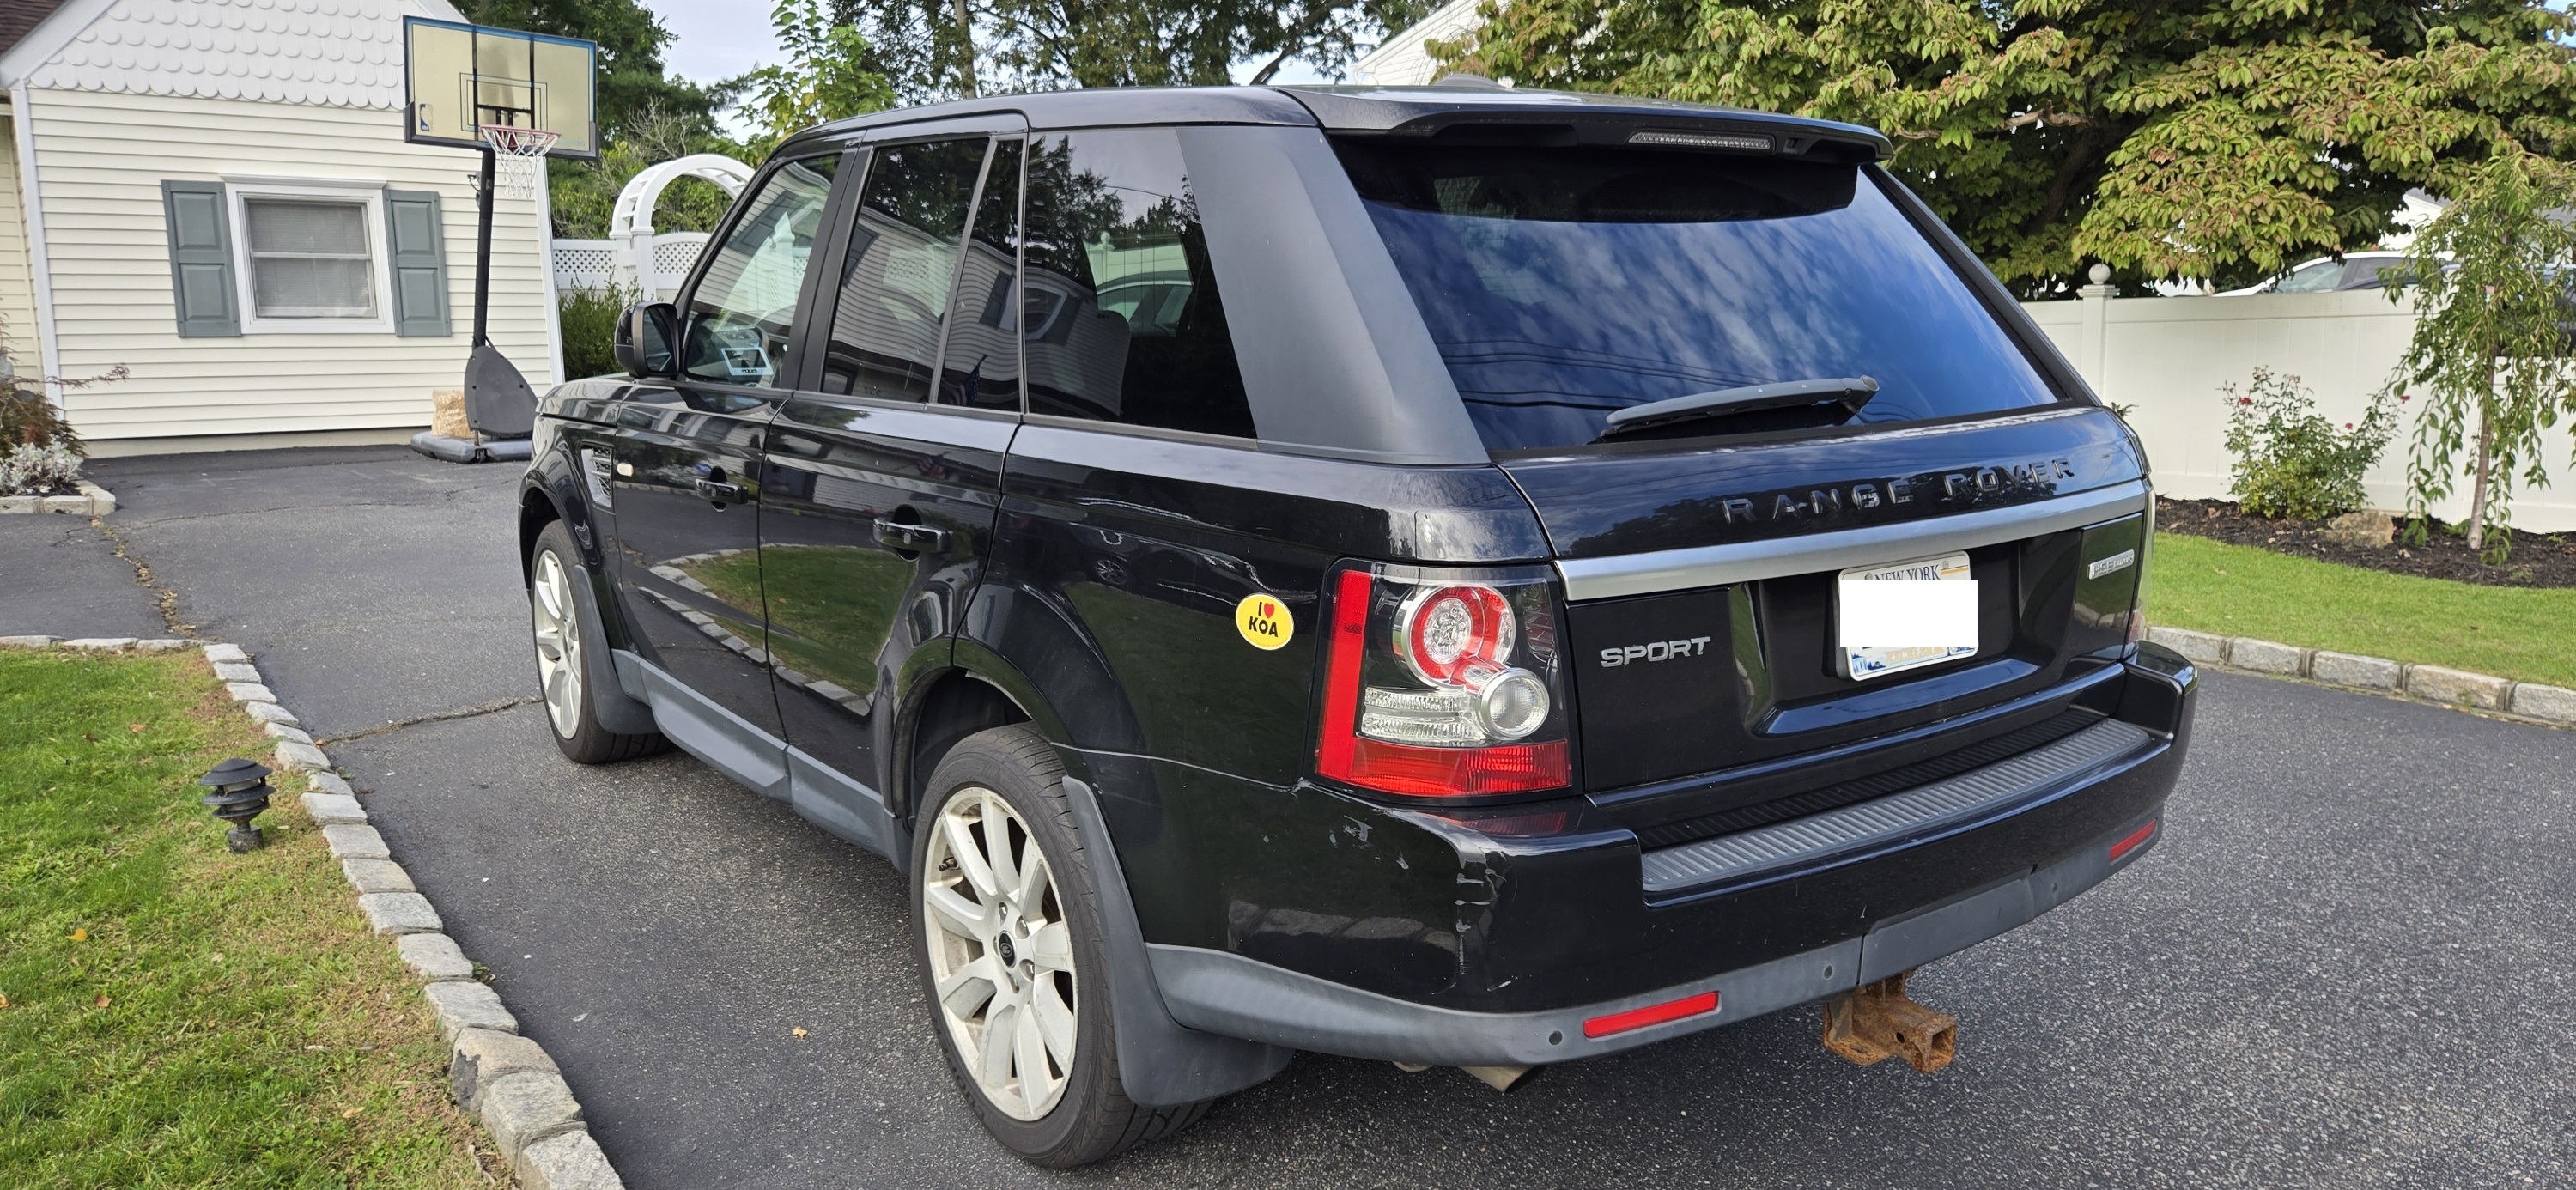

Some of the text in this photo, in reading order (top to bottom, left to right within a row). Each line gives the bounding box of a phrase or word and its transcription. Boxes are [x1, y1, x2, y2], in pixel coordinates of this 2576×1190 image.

[1723, 458, 2075, 525] RANGE ROVER
[1906, 564, 1941, 581] YORK
[1258, 601, 1262, 616] I
[1249, 616, 1278, 637] KOA
[1601, 636, 1711, 668] SPORT
